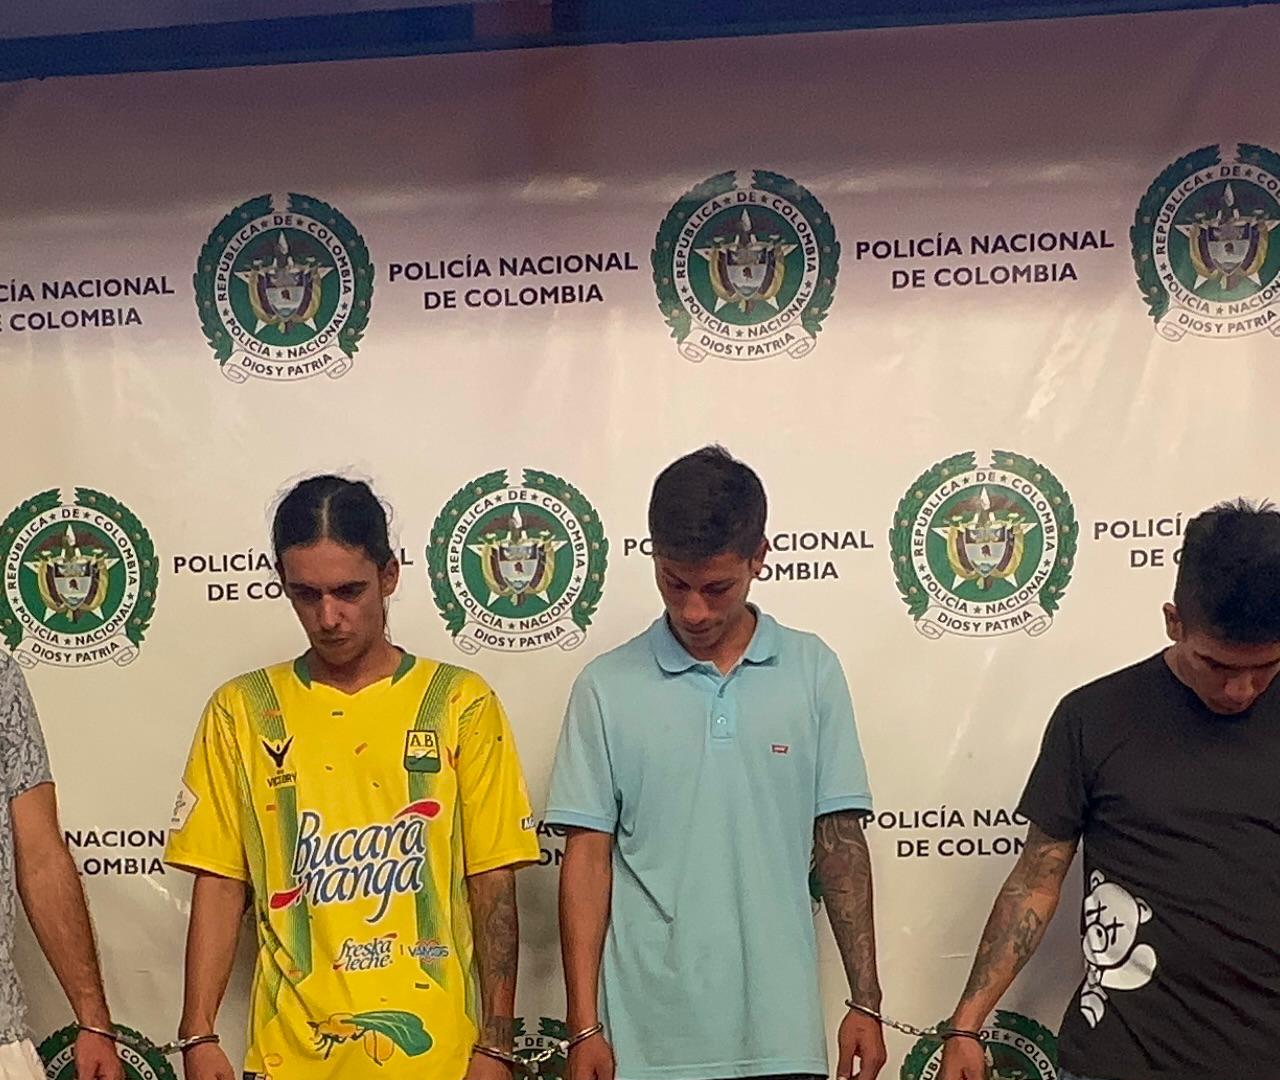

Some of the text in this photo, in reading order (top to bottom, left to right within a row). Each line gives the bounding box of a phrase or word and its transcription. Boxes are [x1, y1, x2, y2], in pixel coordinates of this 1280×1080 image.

[1156, 176, 1203, 255] REPUBLICA
[1220, 167, 1240, 177] DE
[677, 193, 816, 279] REPUBLICA DE COLOMBIA
[856, 230, 1114, 260] POLICÍA NACIONAL
[218, 216, 352, 302] REPUBLICA DE COLOMBIA
[389, 252, 638, 282] POLICÍA NACIONAL
[893, 263, 1077, 288] DE COLOMBIA
[42, 276, 175, 300] NACIONAL
[425, 284, 603, 309] DE COLOMBIA
[10, 308, 142, 331] COLOMBIA
[748, 290, 811, 337] NACIONAL
[1178, 310, 1277, 333] DIOS PATRIA
[288, 311, 347, 358] NACIONAL
[700, 333, 795, 355] DIOS PATRIA
[242, 353, 332, 376] DIOS PATRIA
[915, 472, 1055, 557] REPUBLICA DE COLOMBIA
[1094, 513, 1182, 540] POLICÍ
[451, 491, 586, 573] REPUBLICA DE COLOMBIA
[773, 531, 874, 552] CIONAL
[8, 509, 137, 590] REPUBLICA DE COLOMBIA
[174, 549, 271, 573] POLICÍA
[1131, 549, 1164, 567] DE
[757, 562, 838, 581] OMBIA
[208, 584, 238, 601] DE
[986, 568, 1048, 614] NACIONAL
[520, 583, 580, 629] NACIONAL
[75, 599, 134, 645] NACIONAL
[937, 610, 1032, 631] DIOS PATRIA
[474, 626, 565, 647] DIOS PATRIA
[32, 642, 120, 662] DIOS PATRIA
[863, 805, 965, 829] POLICÍA
[65, 830, 164, 847] NACION
[292, 812, 425, 875] Bucara
[897, 840, 929, 857] DE
[83, 858, 165, 875] OMBIA
[525, 1038, 544, 1047] DE
